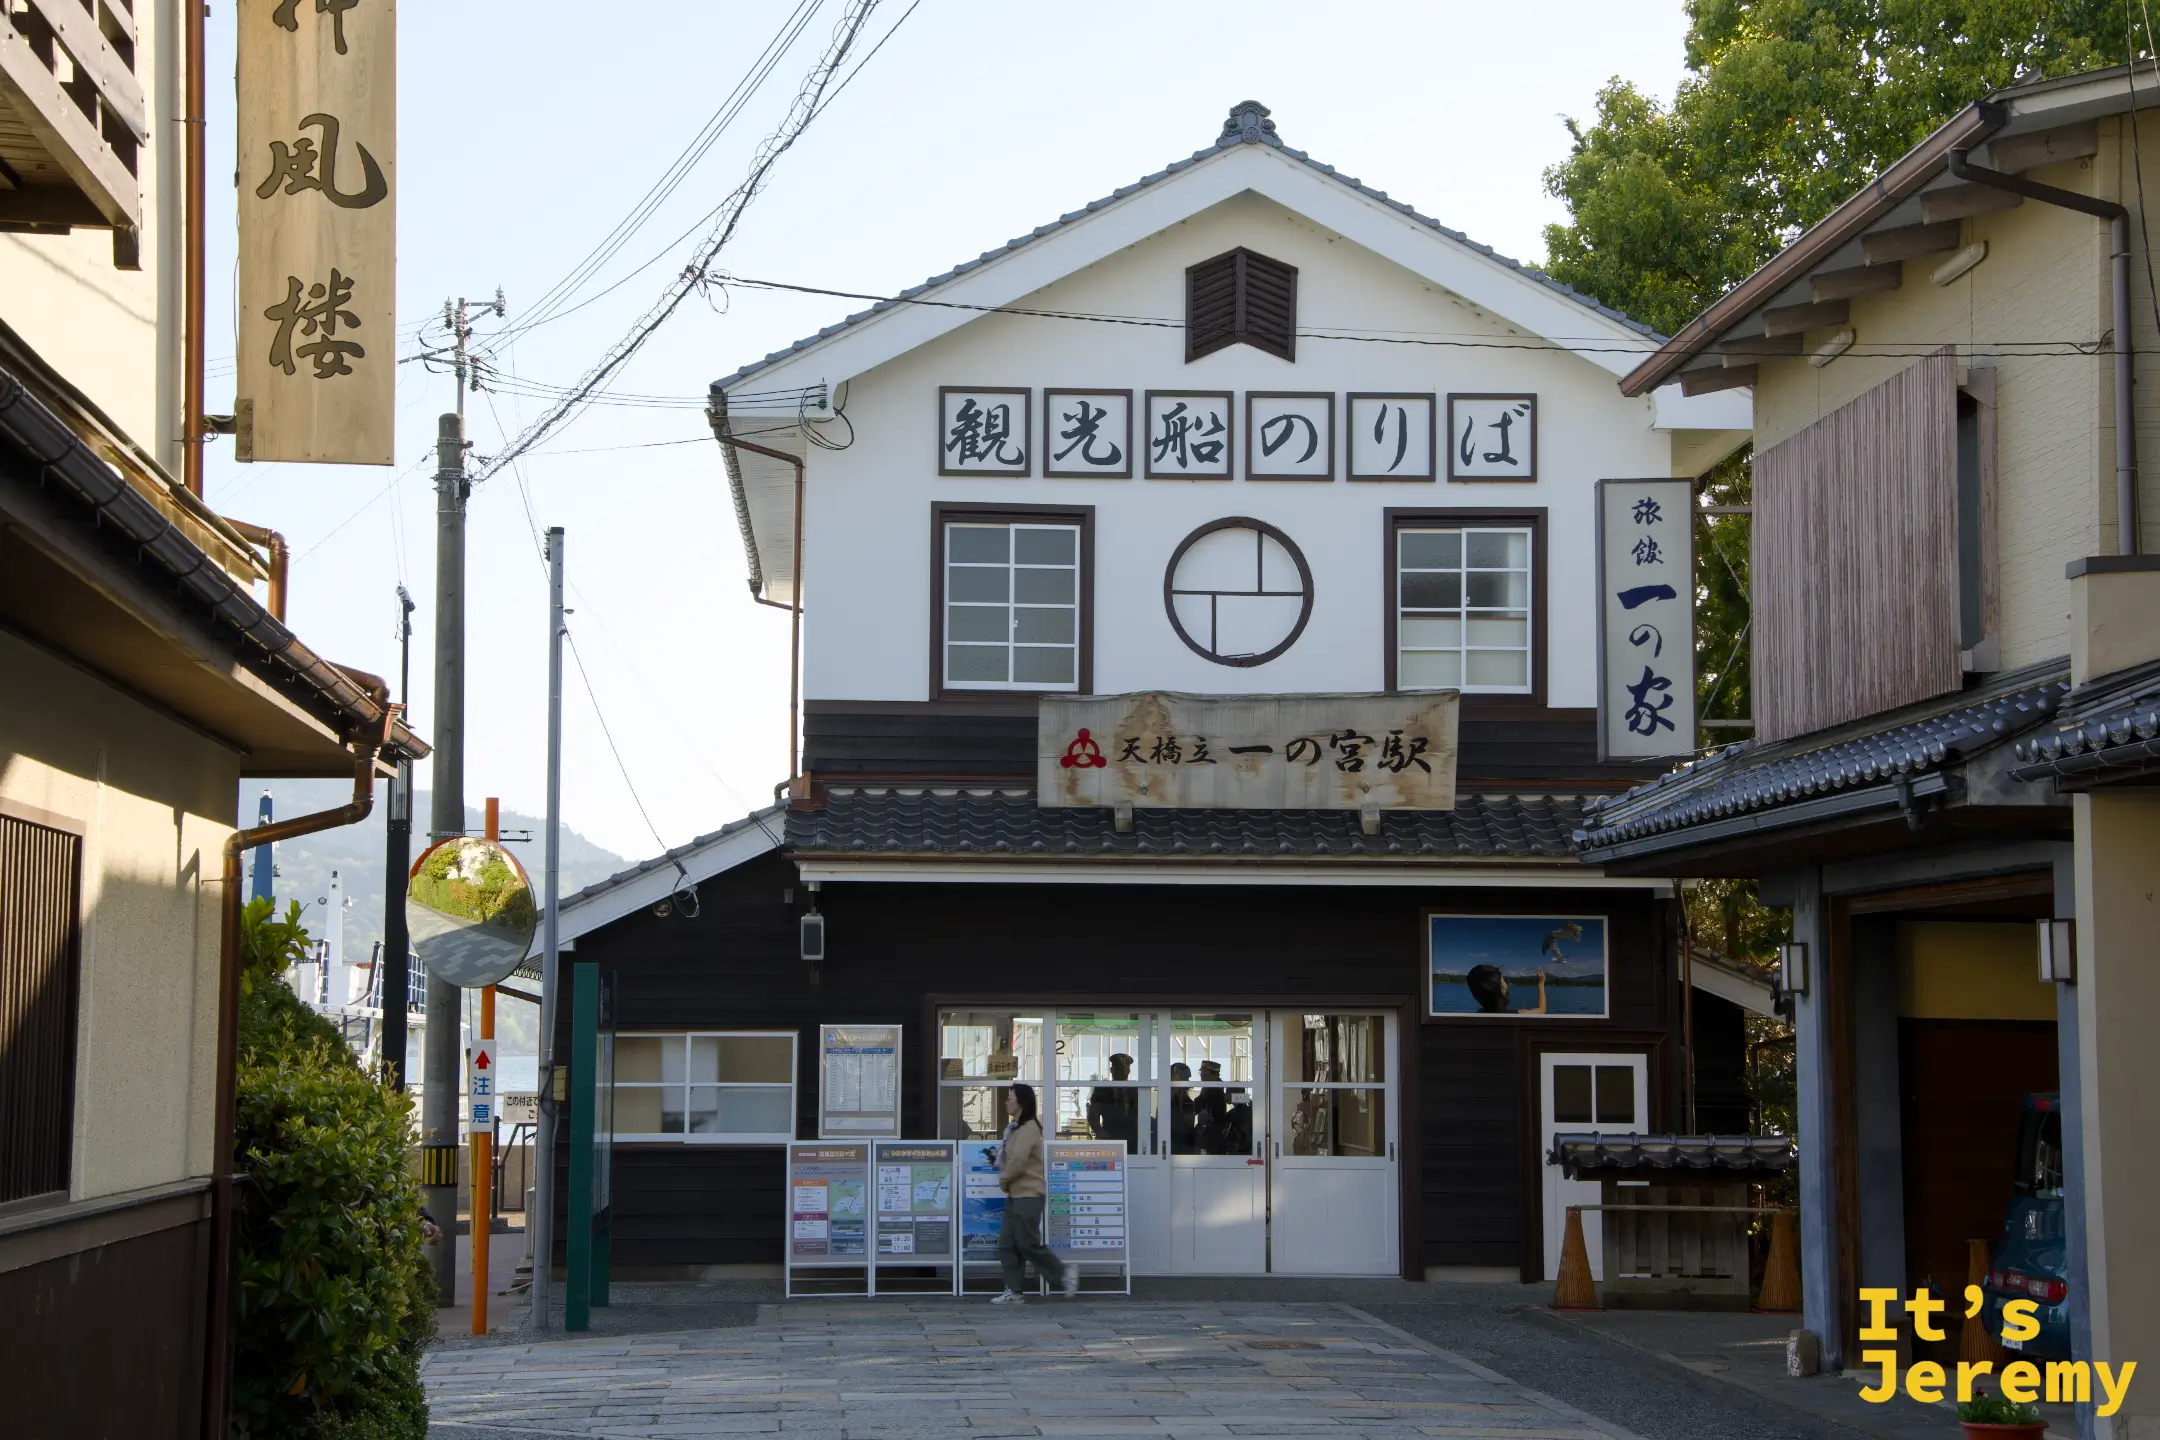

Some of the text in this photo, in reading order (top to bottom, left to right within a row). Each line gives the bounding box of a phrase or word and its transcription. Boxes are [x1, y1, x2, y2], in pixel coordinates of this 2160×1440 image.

[945, 398, 1531, 473] 観光船のりば
[1116, 729, 1433, 774] 天橋立一の宮駅
[472, 1076, 491, 1124] 注意
